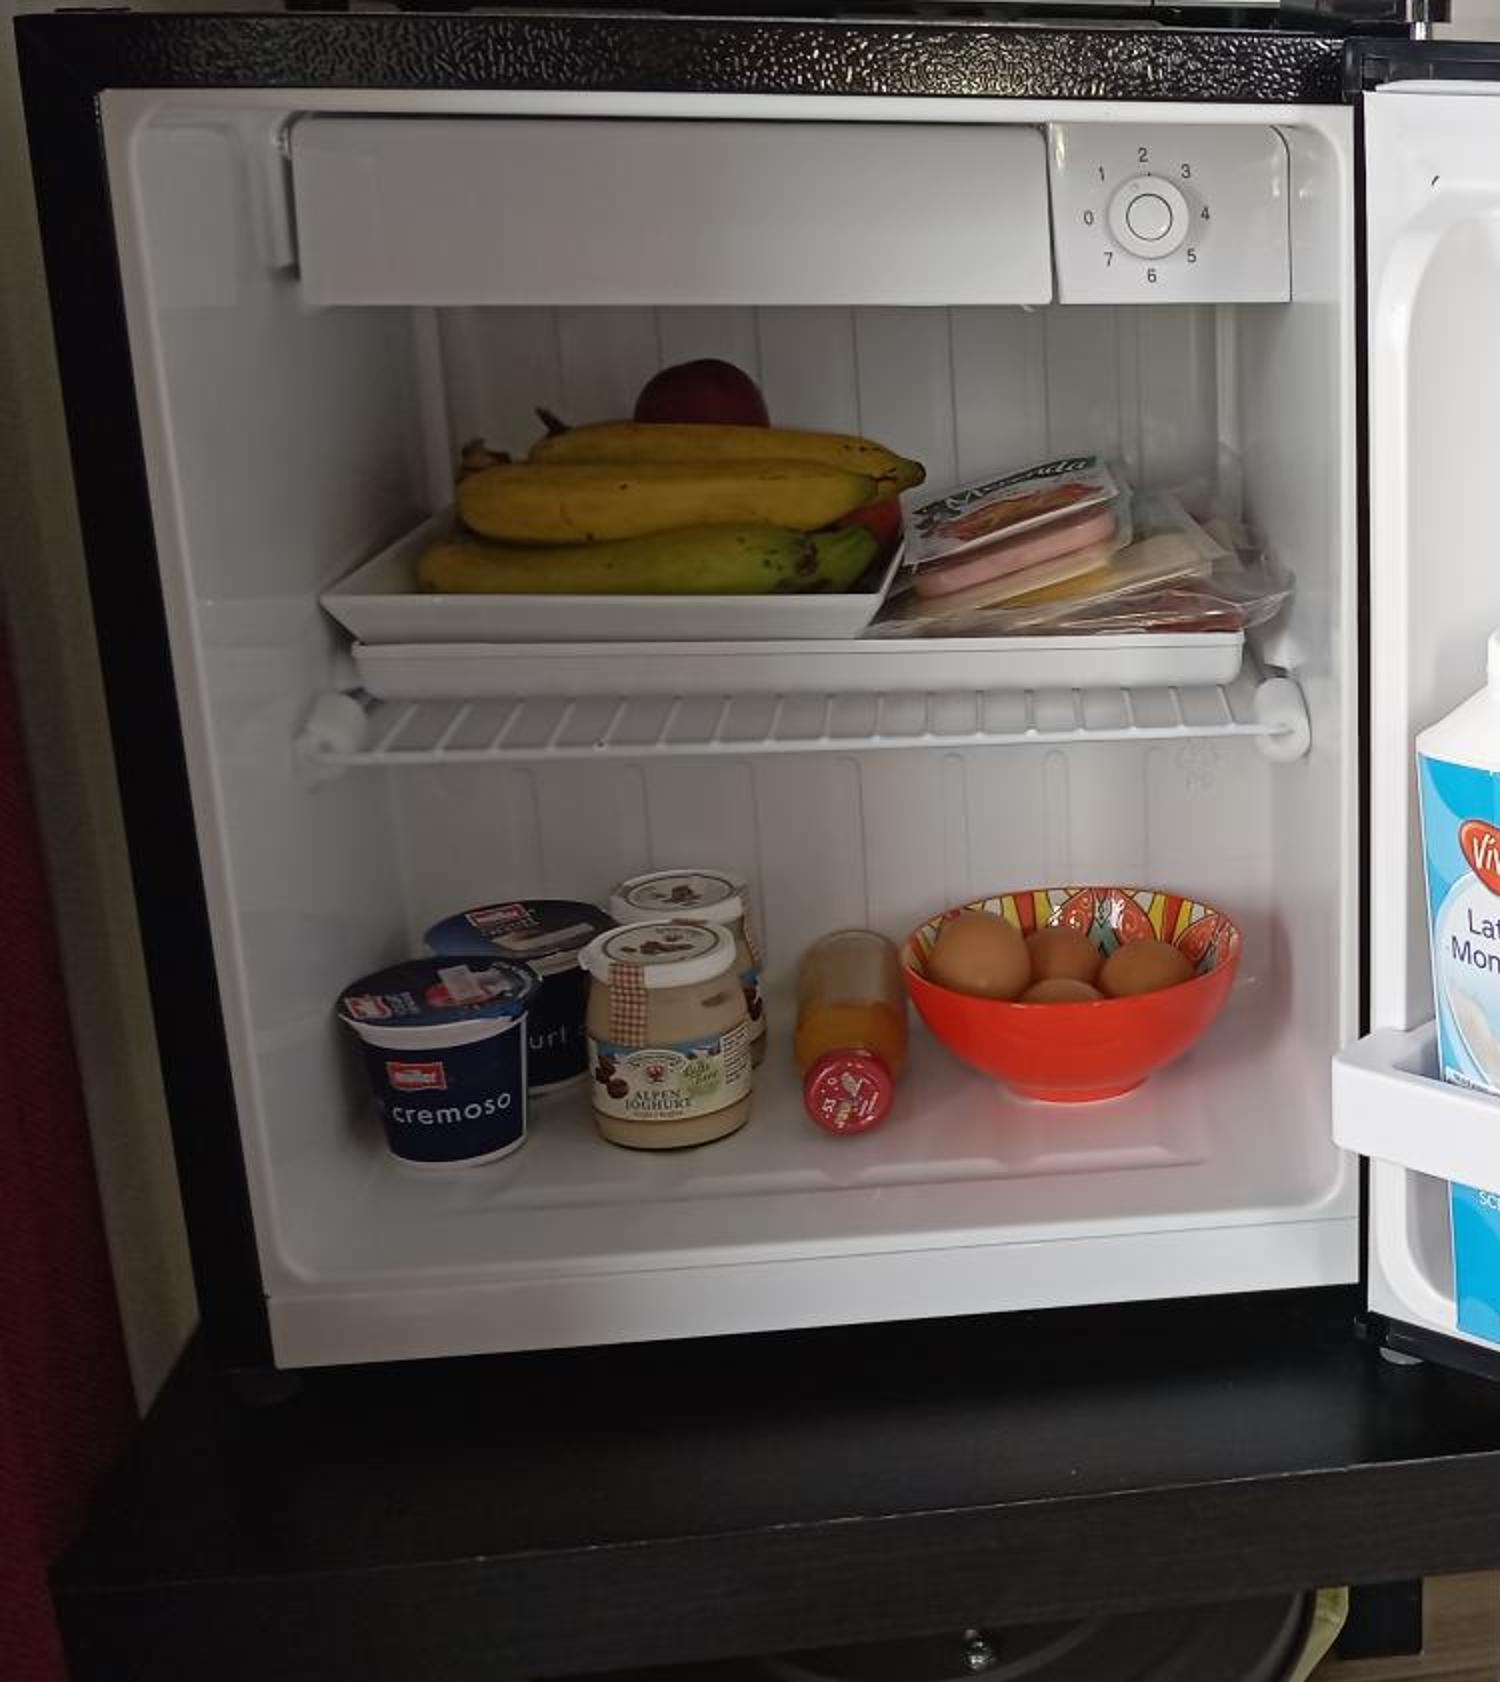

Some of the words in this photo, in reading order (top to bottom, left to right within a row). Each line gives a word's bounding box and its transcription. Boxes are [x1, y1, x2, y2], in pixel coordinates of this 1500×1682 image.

[1138, 147, 1148, 163] 2
[1099, 166, 1105, 181] 1
[1181, 163, 1191, 179] 3
[1084, 210, 1094, 226] 0
[1200, 205, 1210, 221] 4
[1104, 252, 1113, 266] 7
[1187, 249, 1197, 263] 5
[1147, 268, 1157, 283] 6
[634, 1089, 681, 1101] ALPEN
[392, 1092, 512, 1125] cremoso
